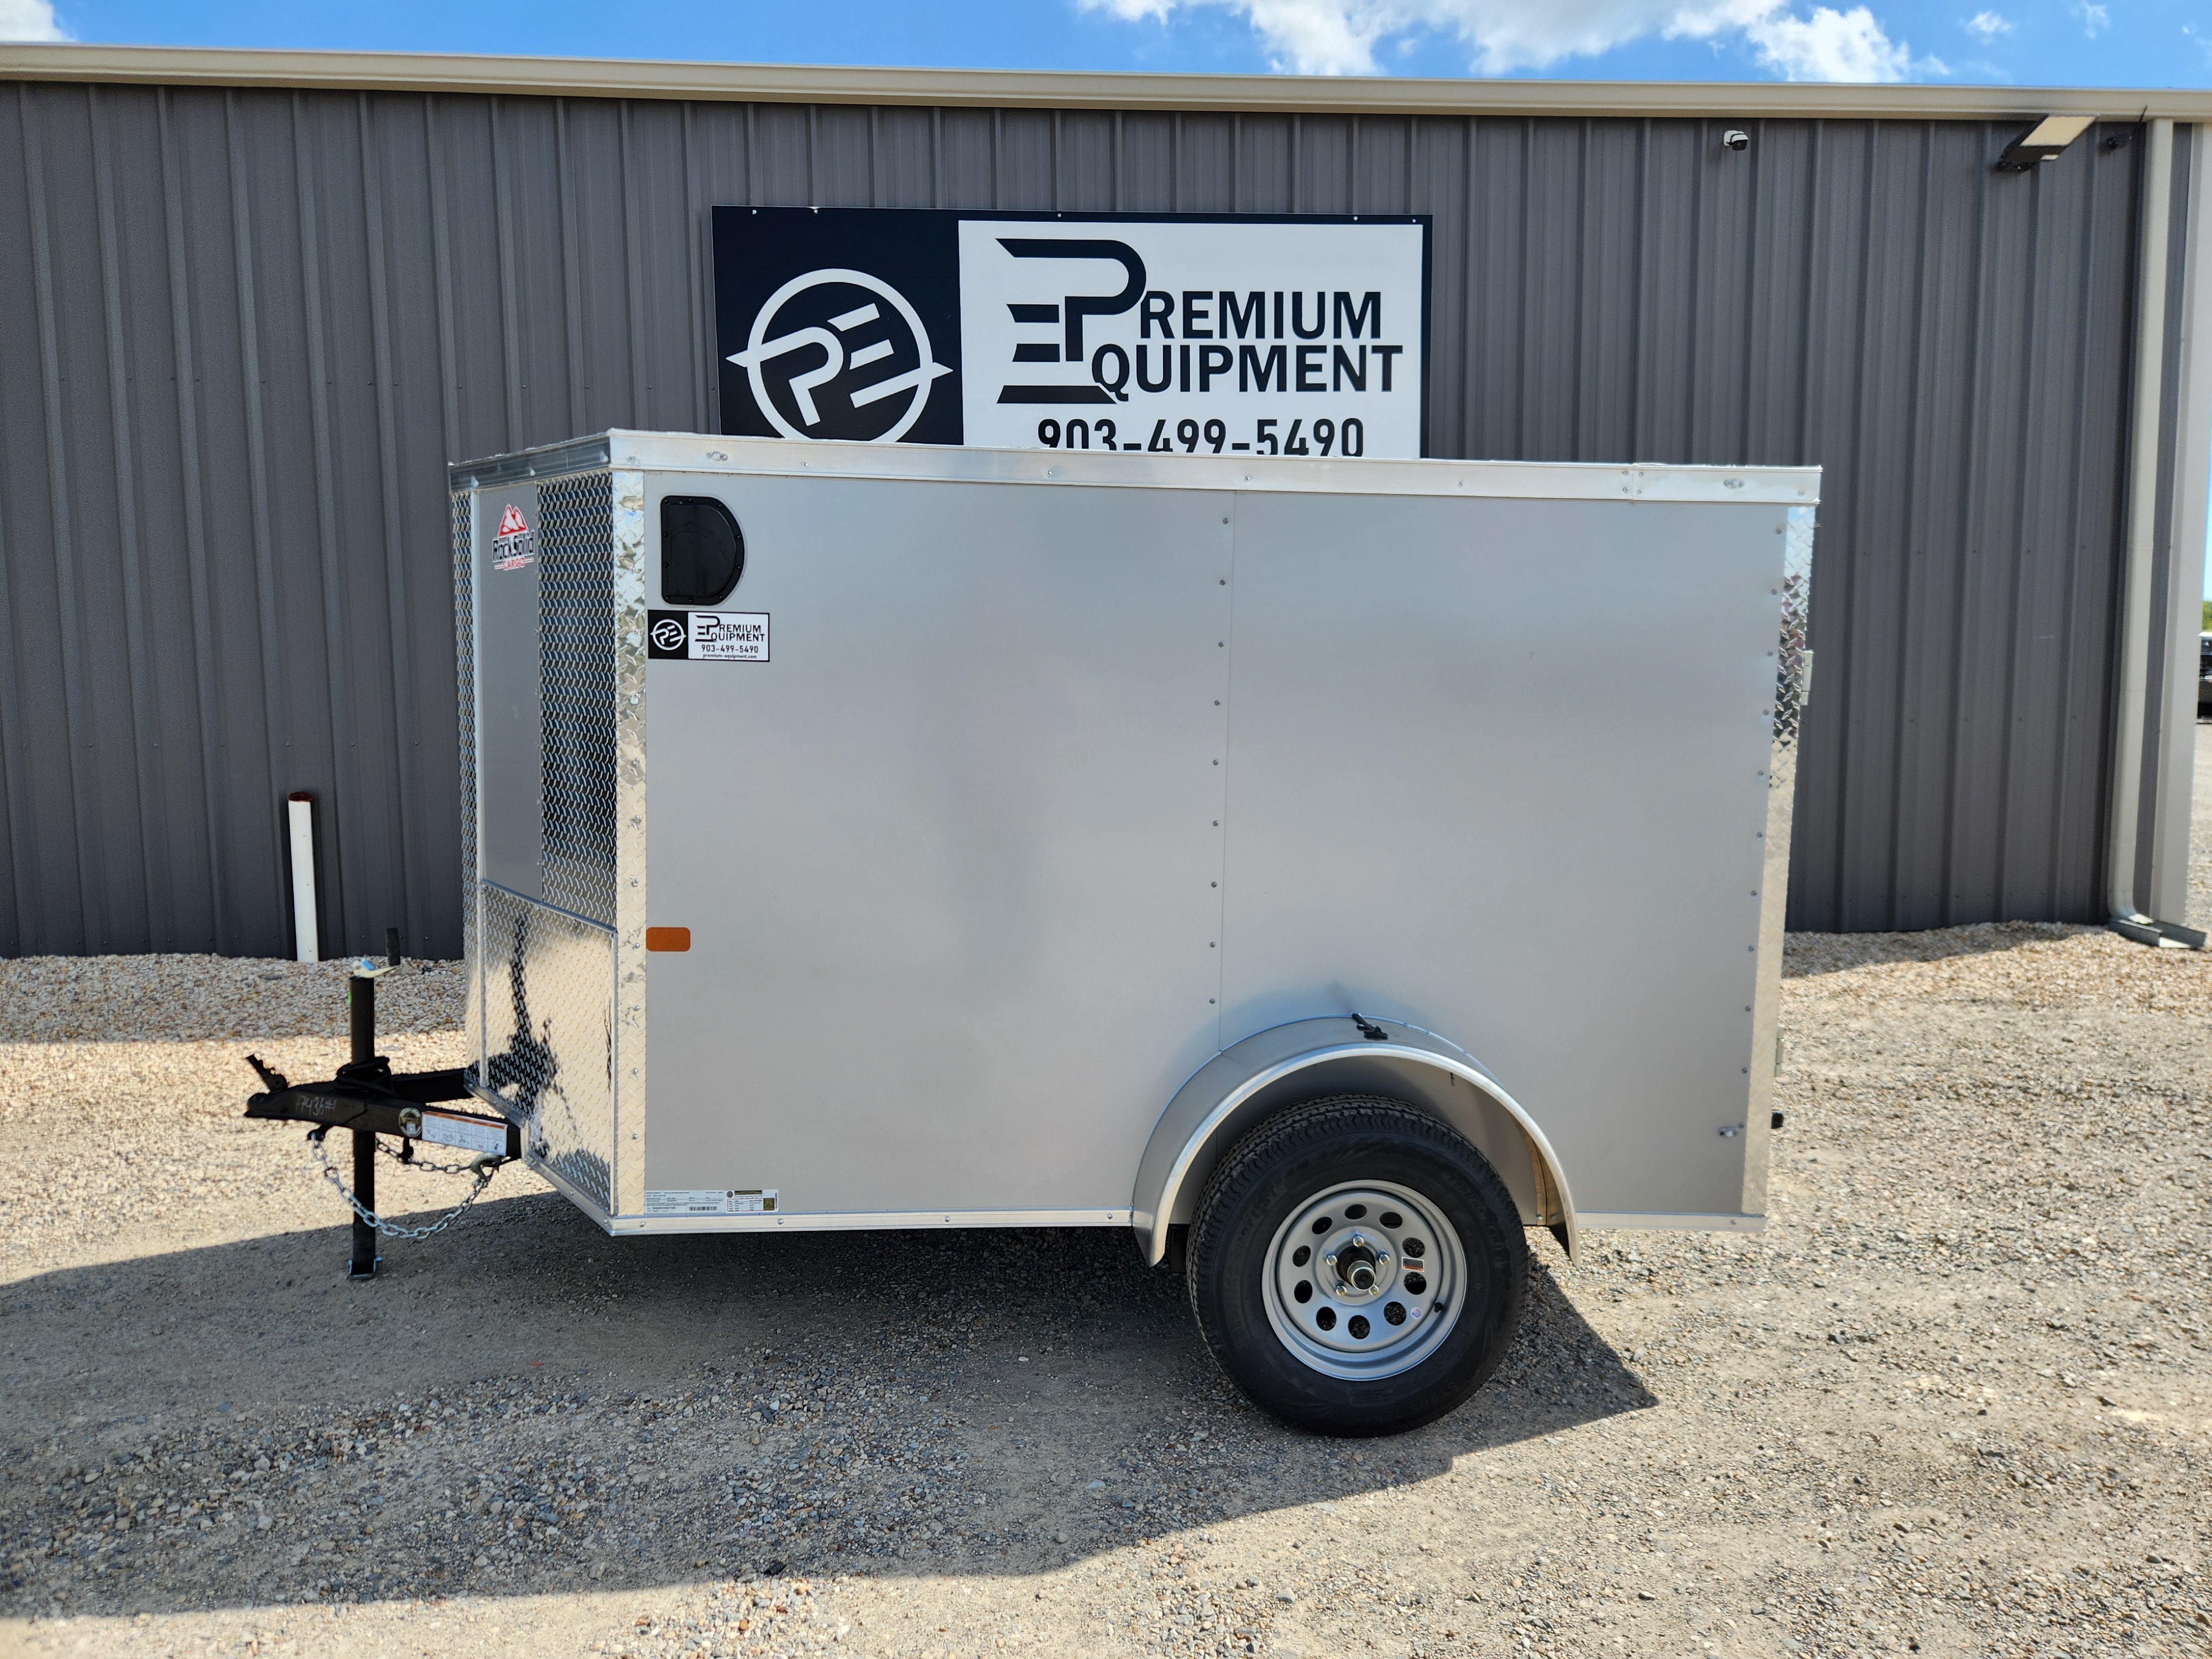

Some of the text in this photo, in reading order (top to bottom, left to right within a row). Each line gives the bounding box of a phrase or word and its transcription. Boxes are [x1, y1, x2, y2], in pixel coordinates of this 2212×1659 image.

[1038, 418, 1364, 457] 903-499-5490
[503, 557, 525, 570] CARGO
[701, 644, 758, 653] 903-499-5490
